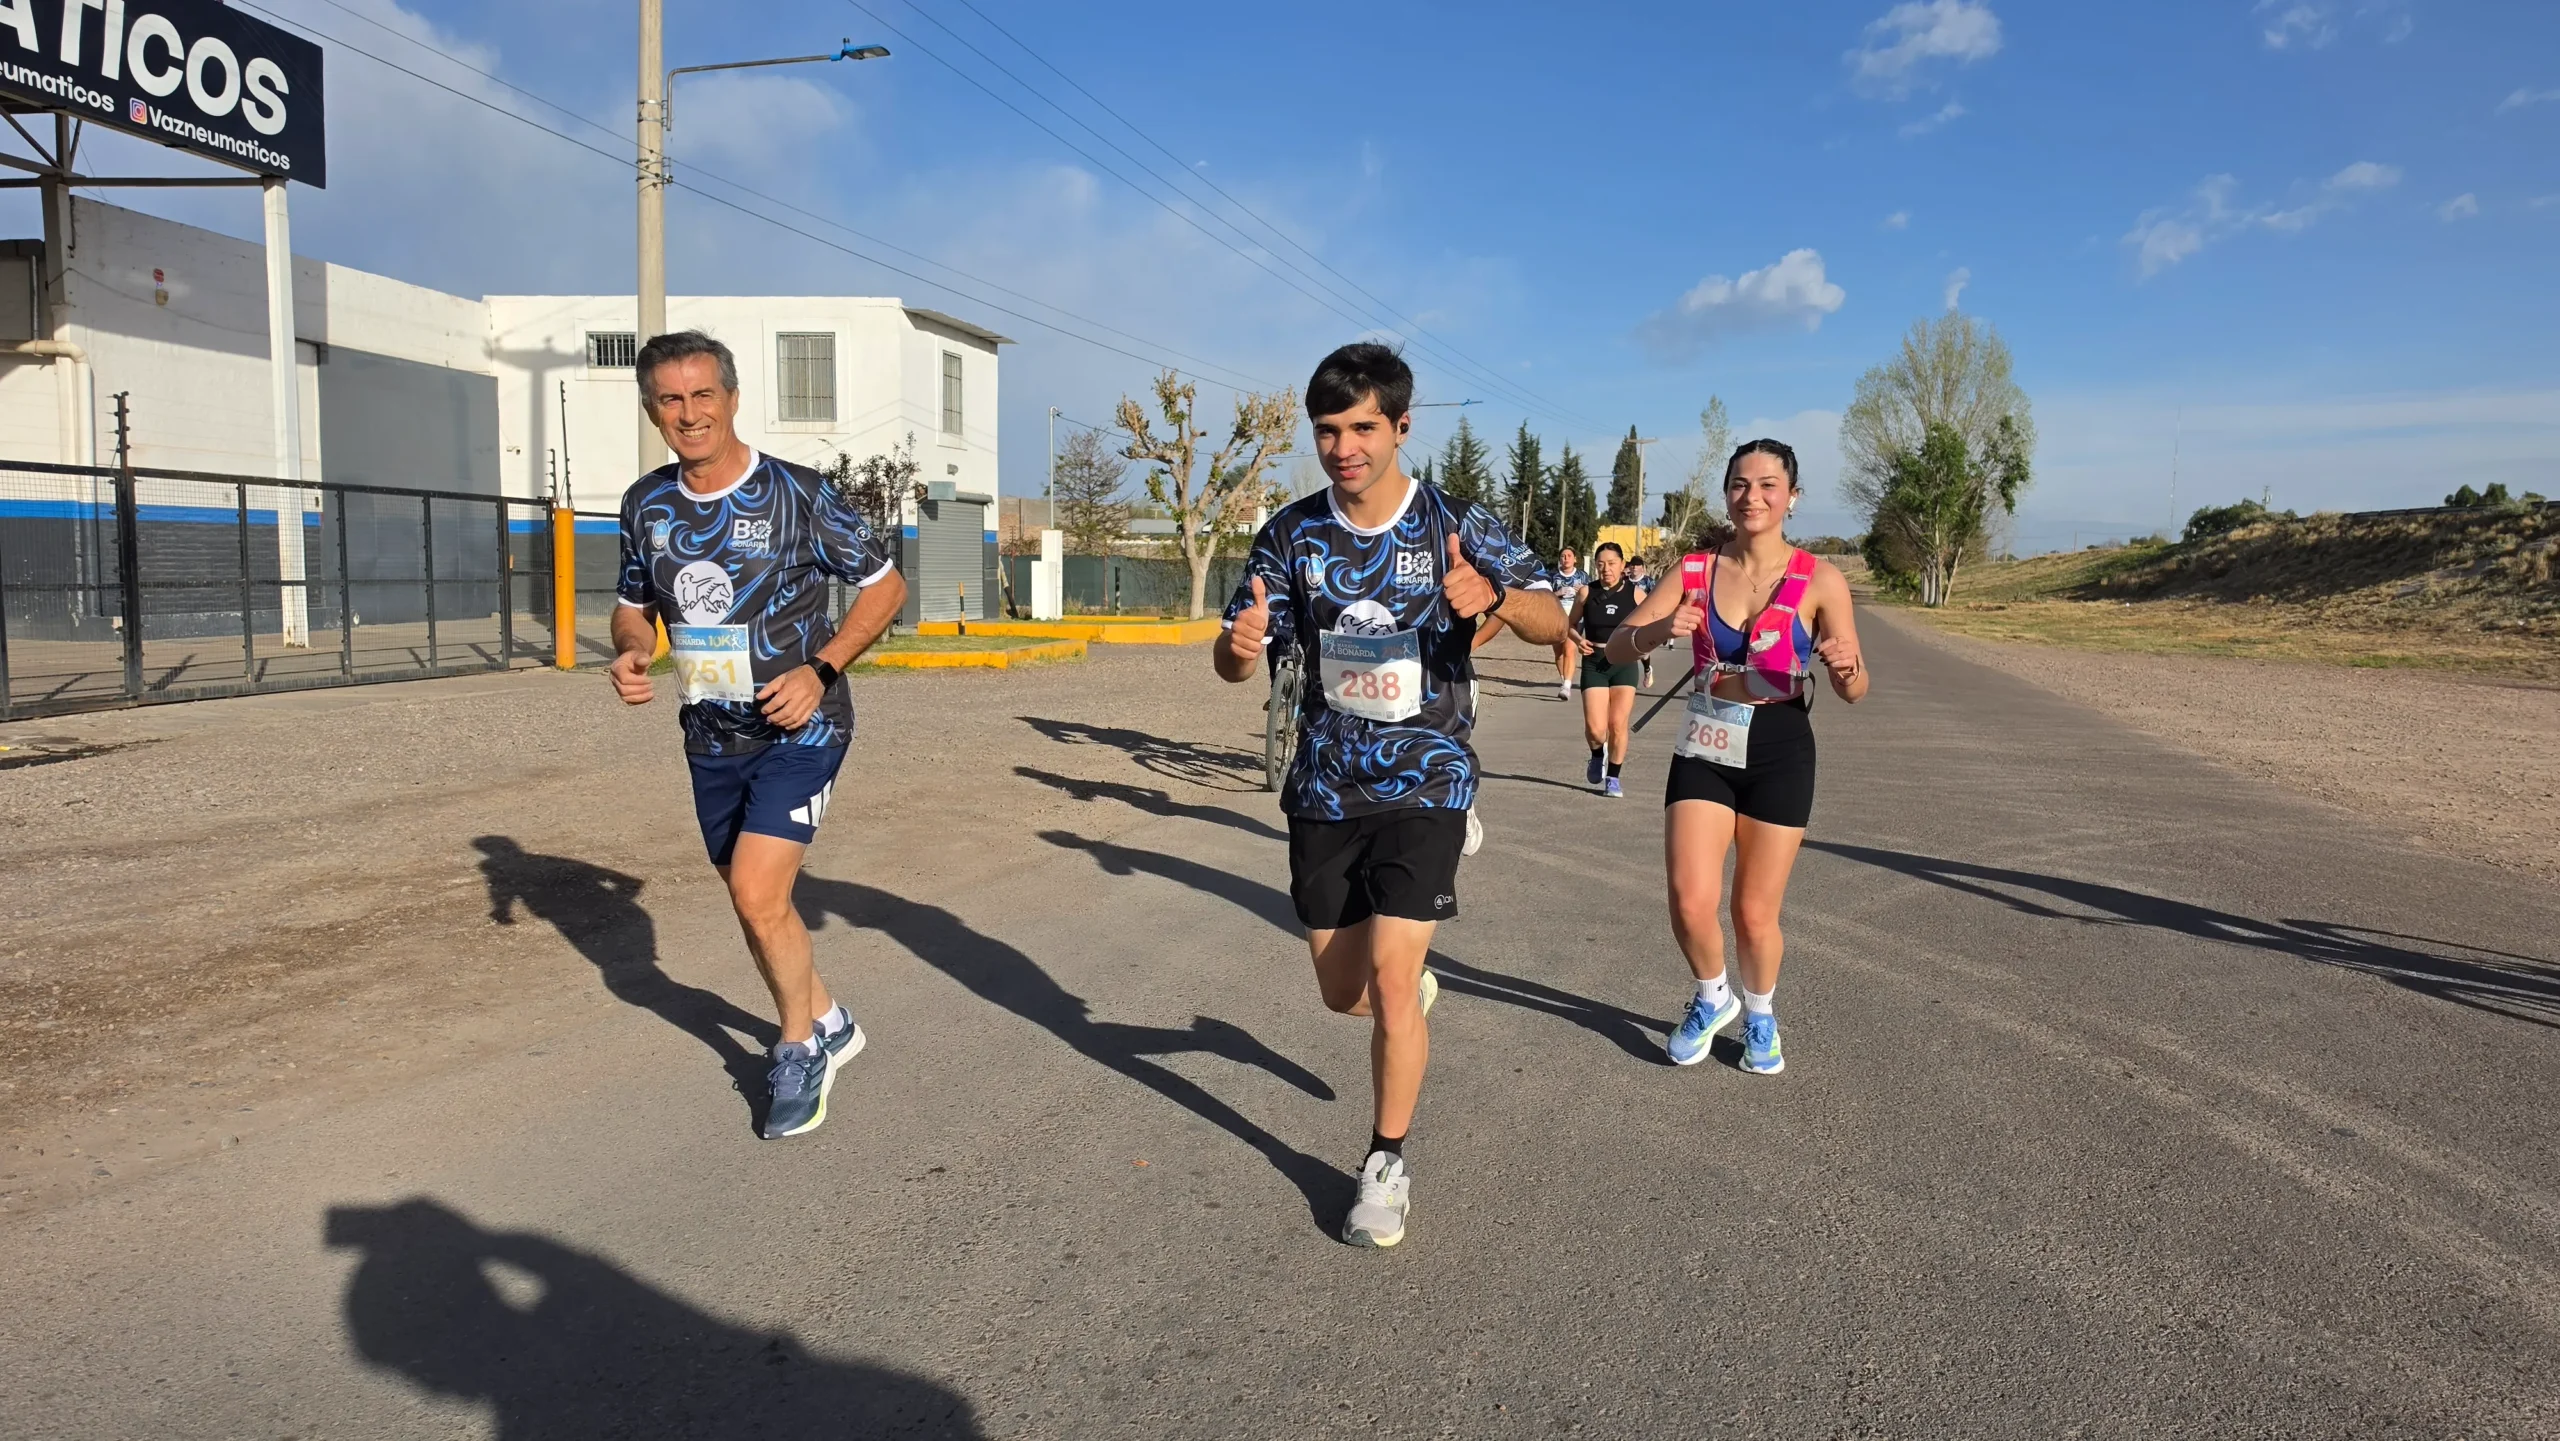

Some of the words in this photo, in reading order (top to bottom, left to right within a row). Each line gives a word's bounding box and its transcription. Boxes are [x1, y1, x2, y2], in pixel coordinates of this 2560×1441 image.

[0, 59, 115, 113] umaticos
[149, 105, 291, 171] Vazneumaticos
[1396, 575, 1433, 585] BONARDA
[1337, 647, 1377, 659] BONARDA
[683, 658, 737, 686] 251
[1340, 669, 1401, 701] 288
[1685, 719, 1729, 751] 268
